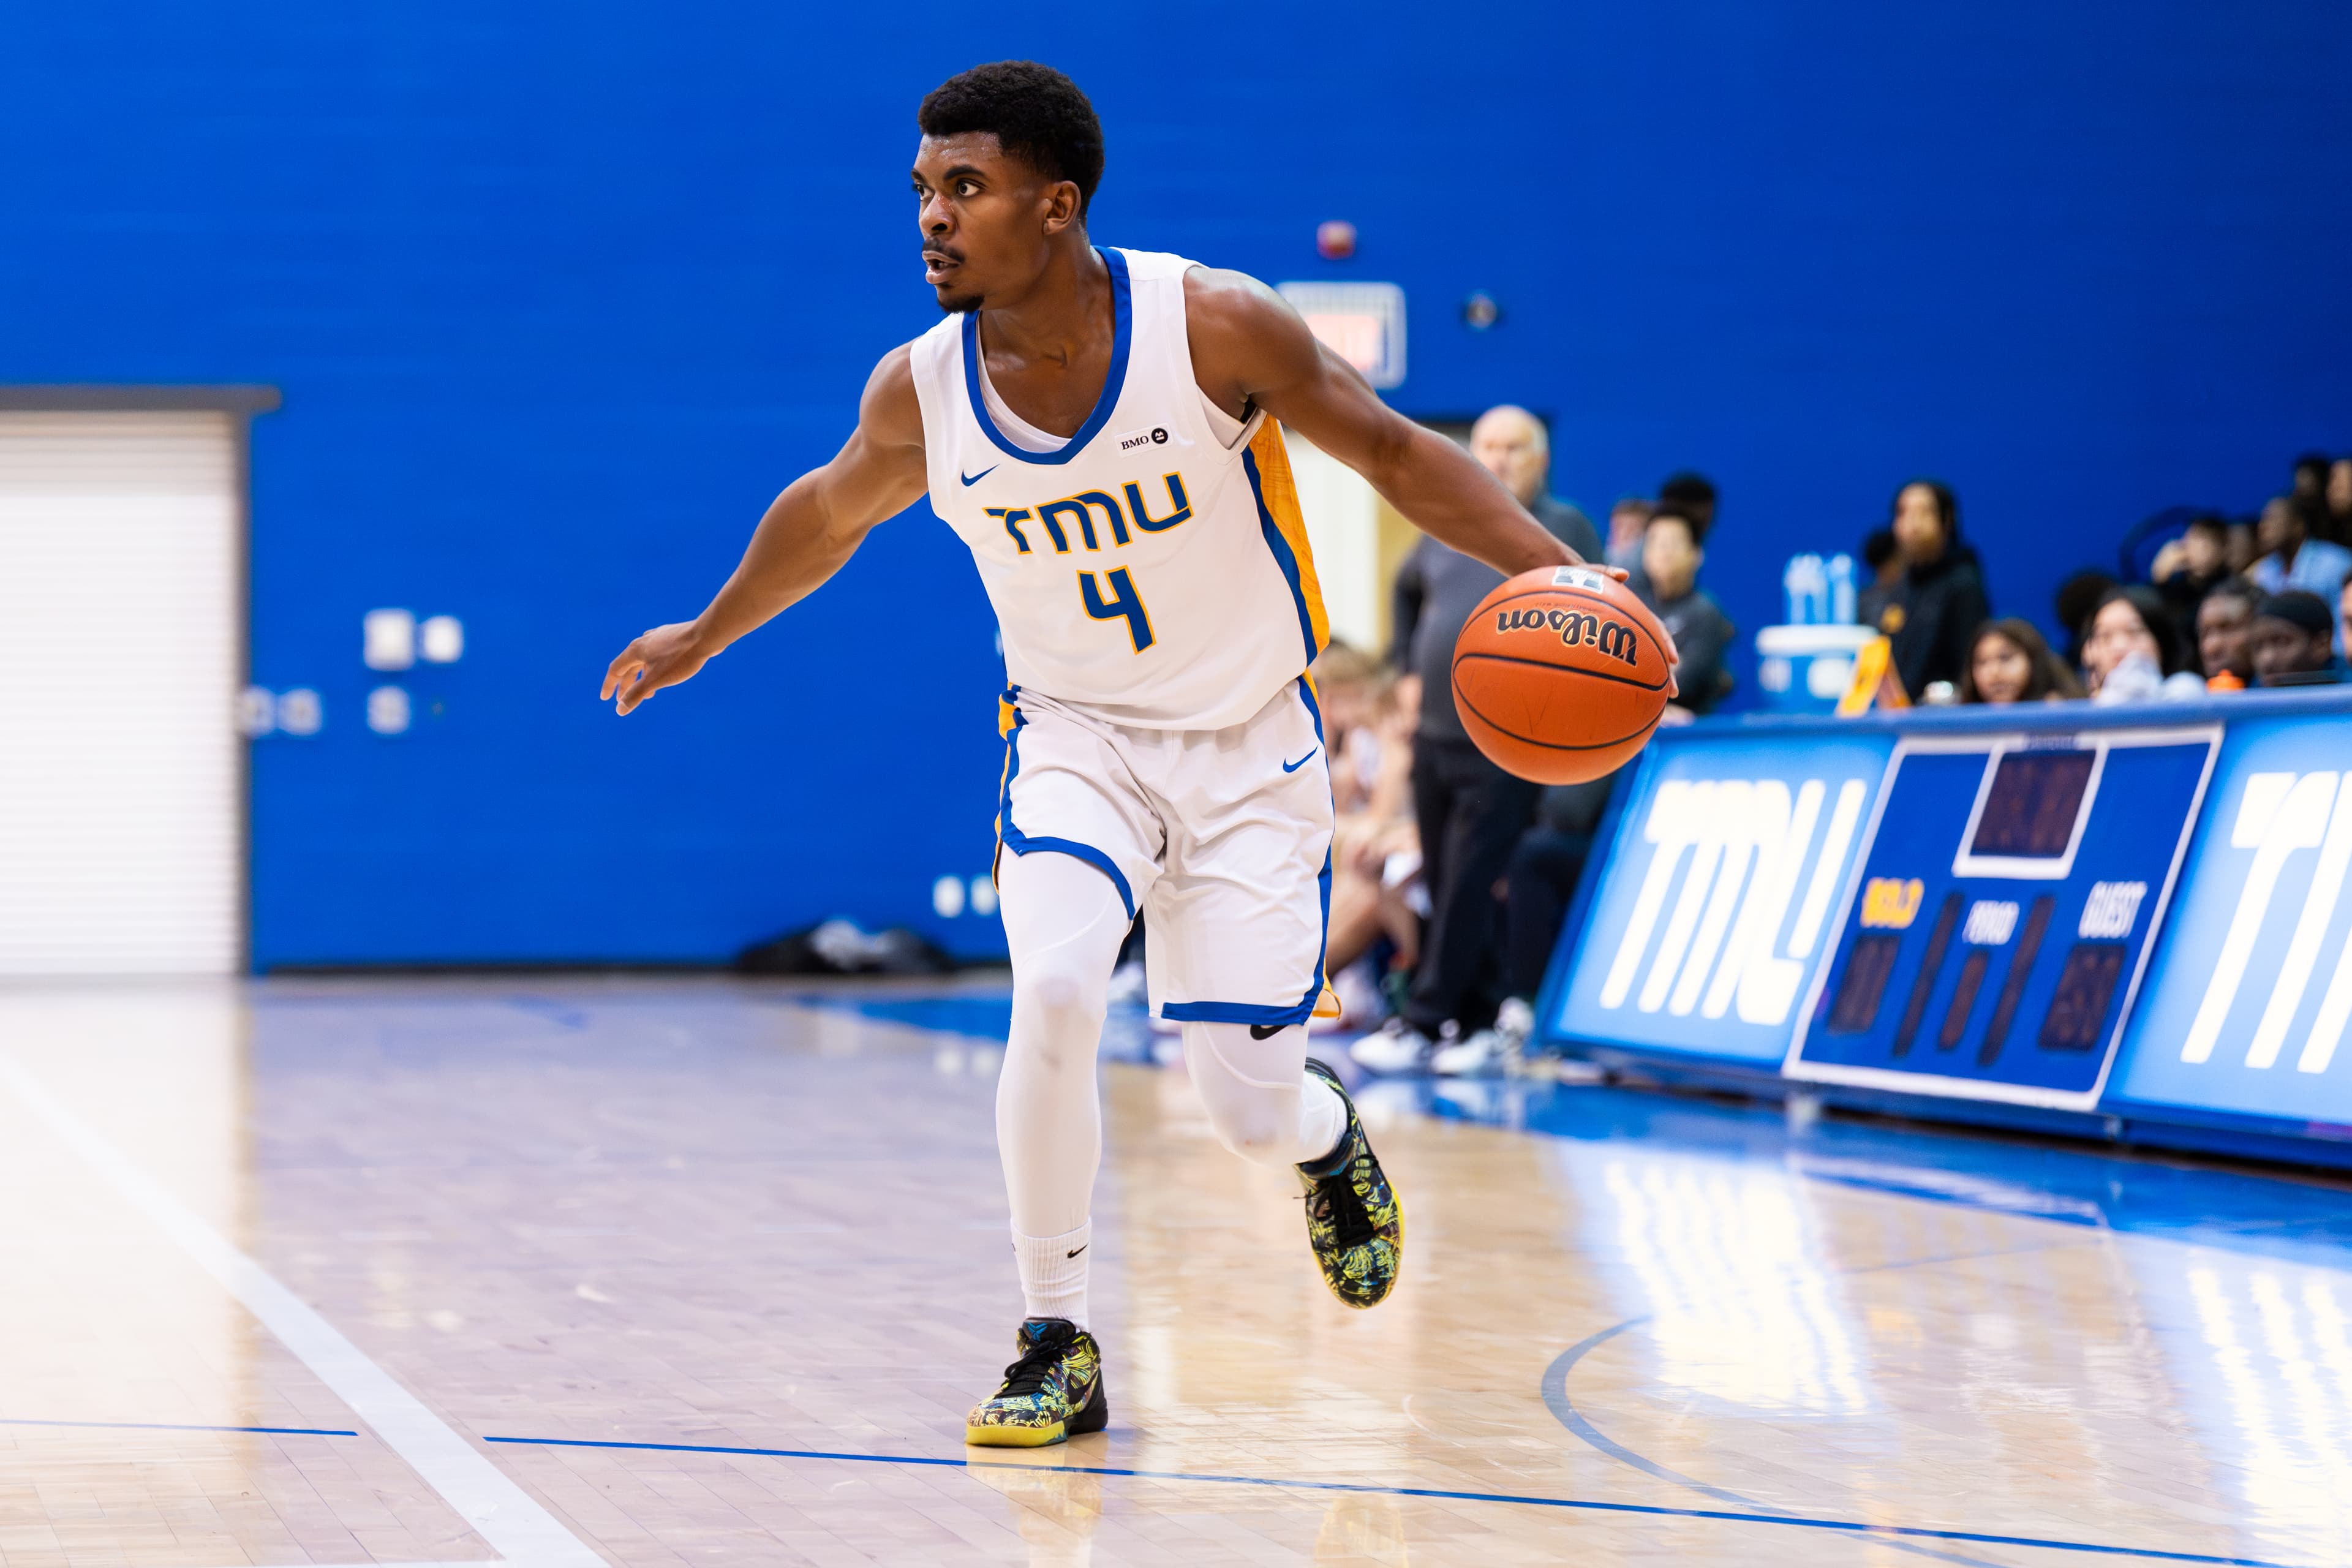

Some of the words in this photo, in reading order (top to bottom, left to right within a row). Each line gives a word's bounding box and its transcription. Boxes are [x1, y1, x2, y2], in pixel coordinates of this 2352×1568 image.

[1120, 435, 1149, 450] BMO
[982, 471, 1194, 555] TMU
[1076, 564, 1156, 655] 4
[1496, 608, 1638, 668] Wilson
[1599, 778, 1868, 1027] TMU
